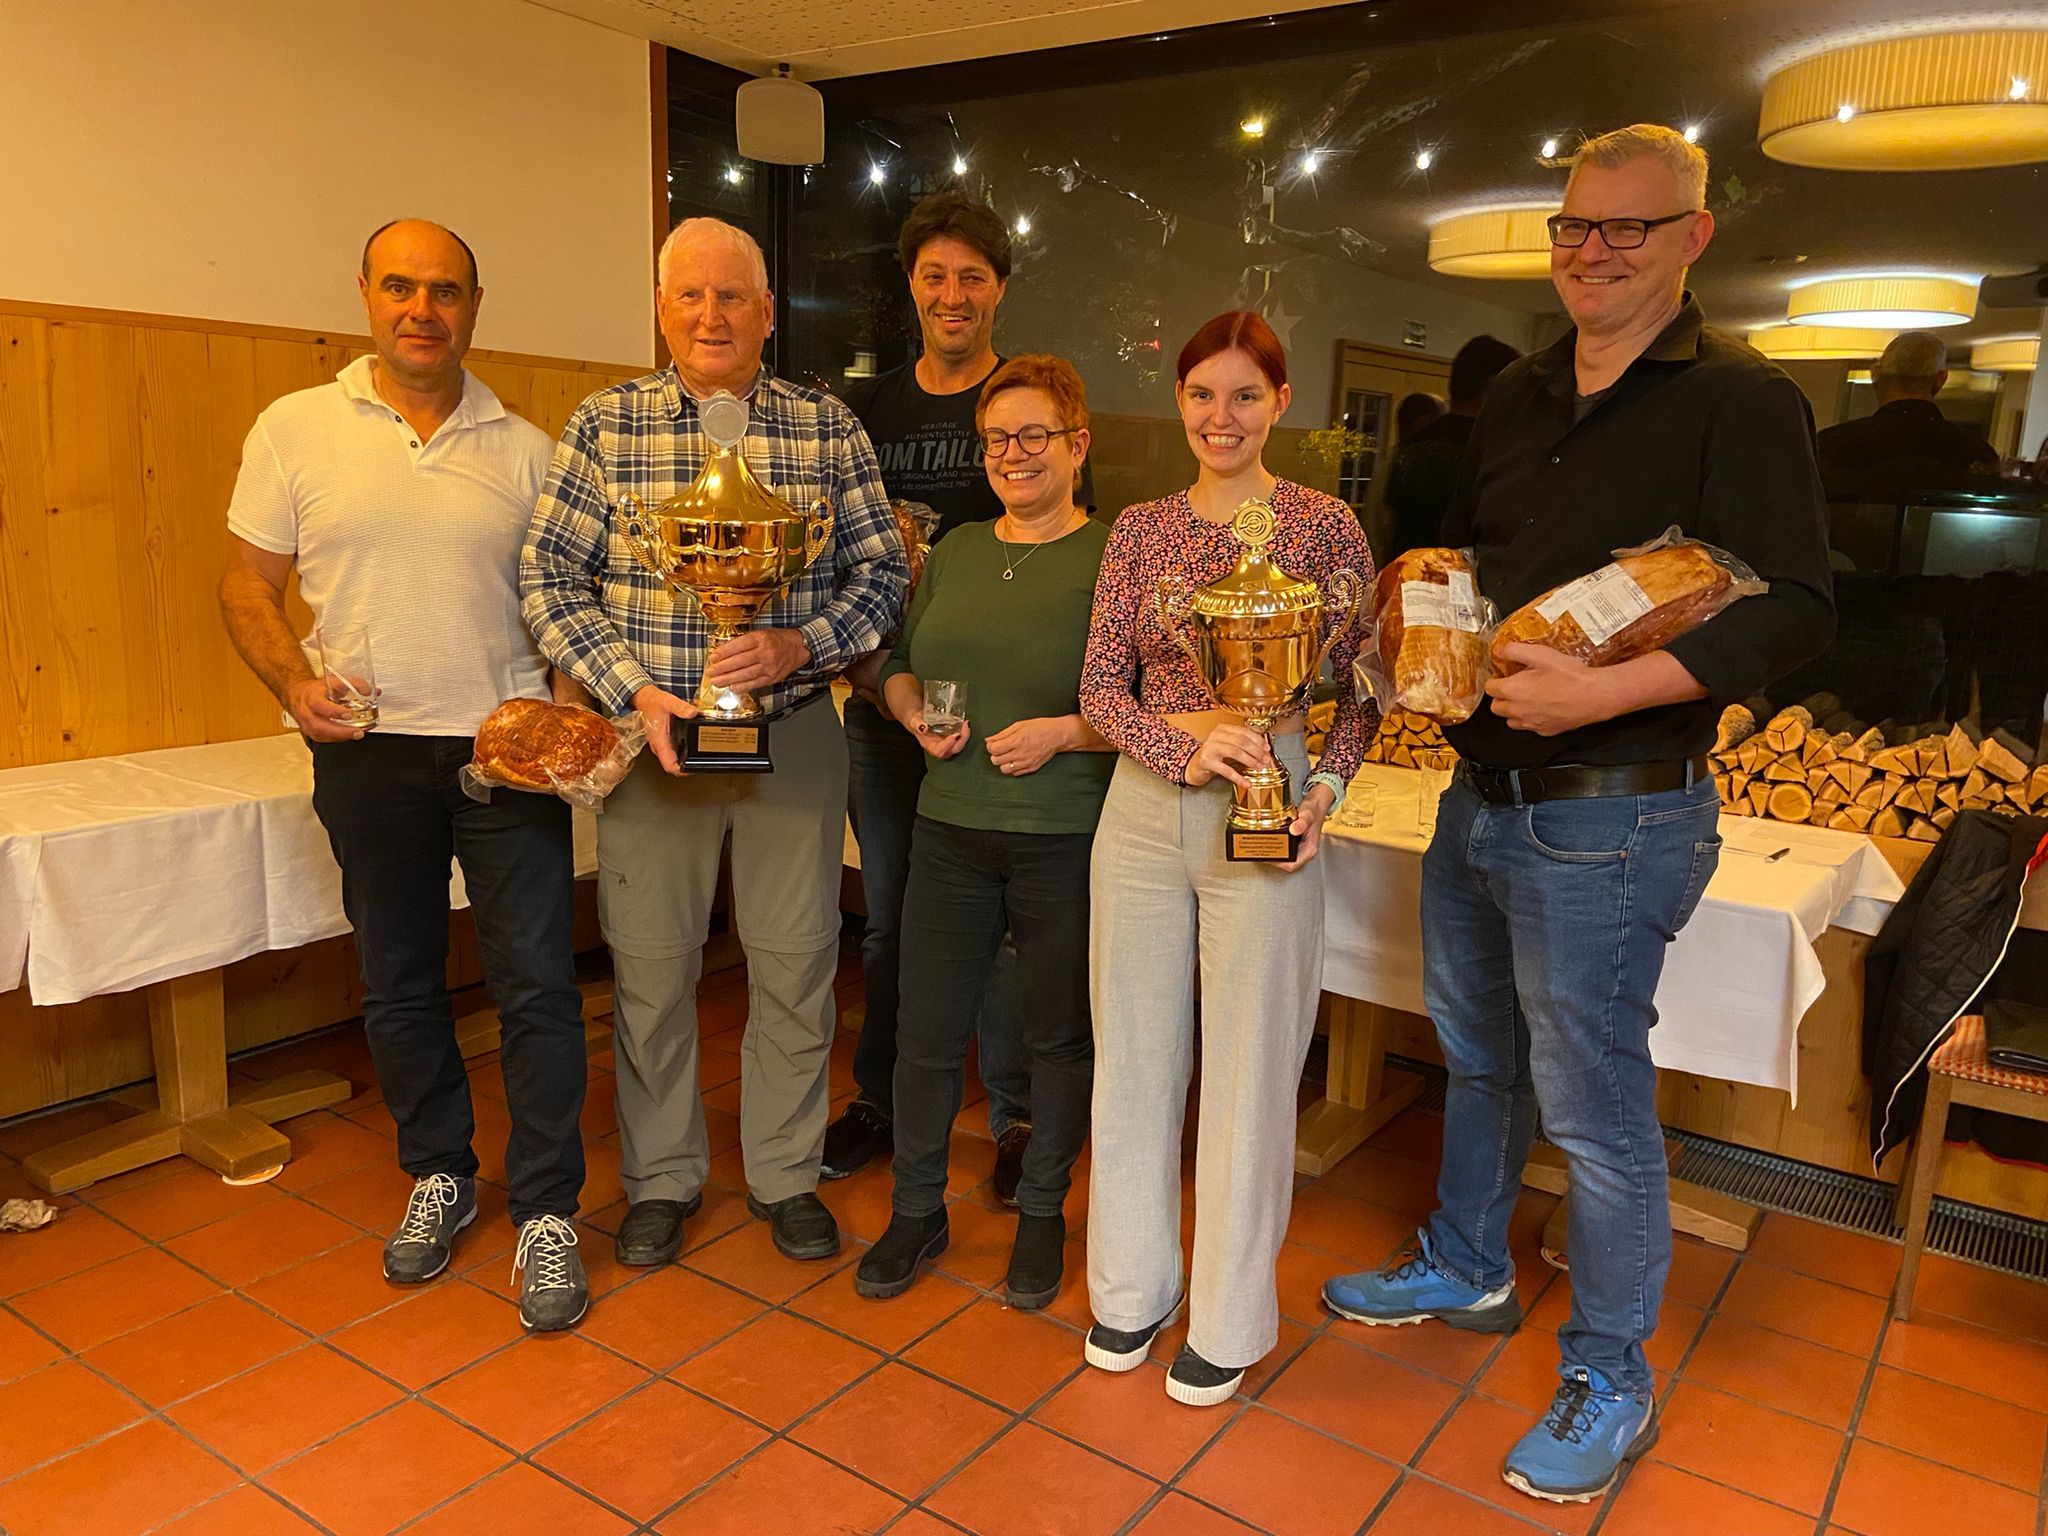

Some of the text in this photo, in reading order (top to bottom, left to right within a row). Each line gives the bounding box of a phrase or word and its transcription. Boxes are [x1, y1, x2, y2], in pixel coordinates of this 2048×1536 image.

[921, 422, 957, 431] HERITAGE
[904, 431, 947, 441] AUTHENTIC
[873, 442, 917, 471] OM
